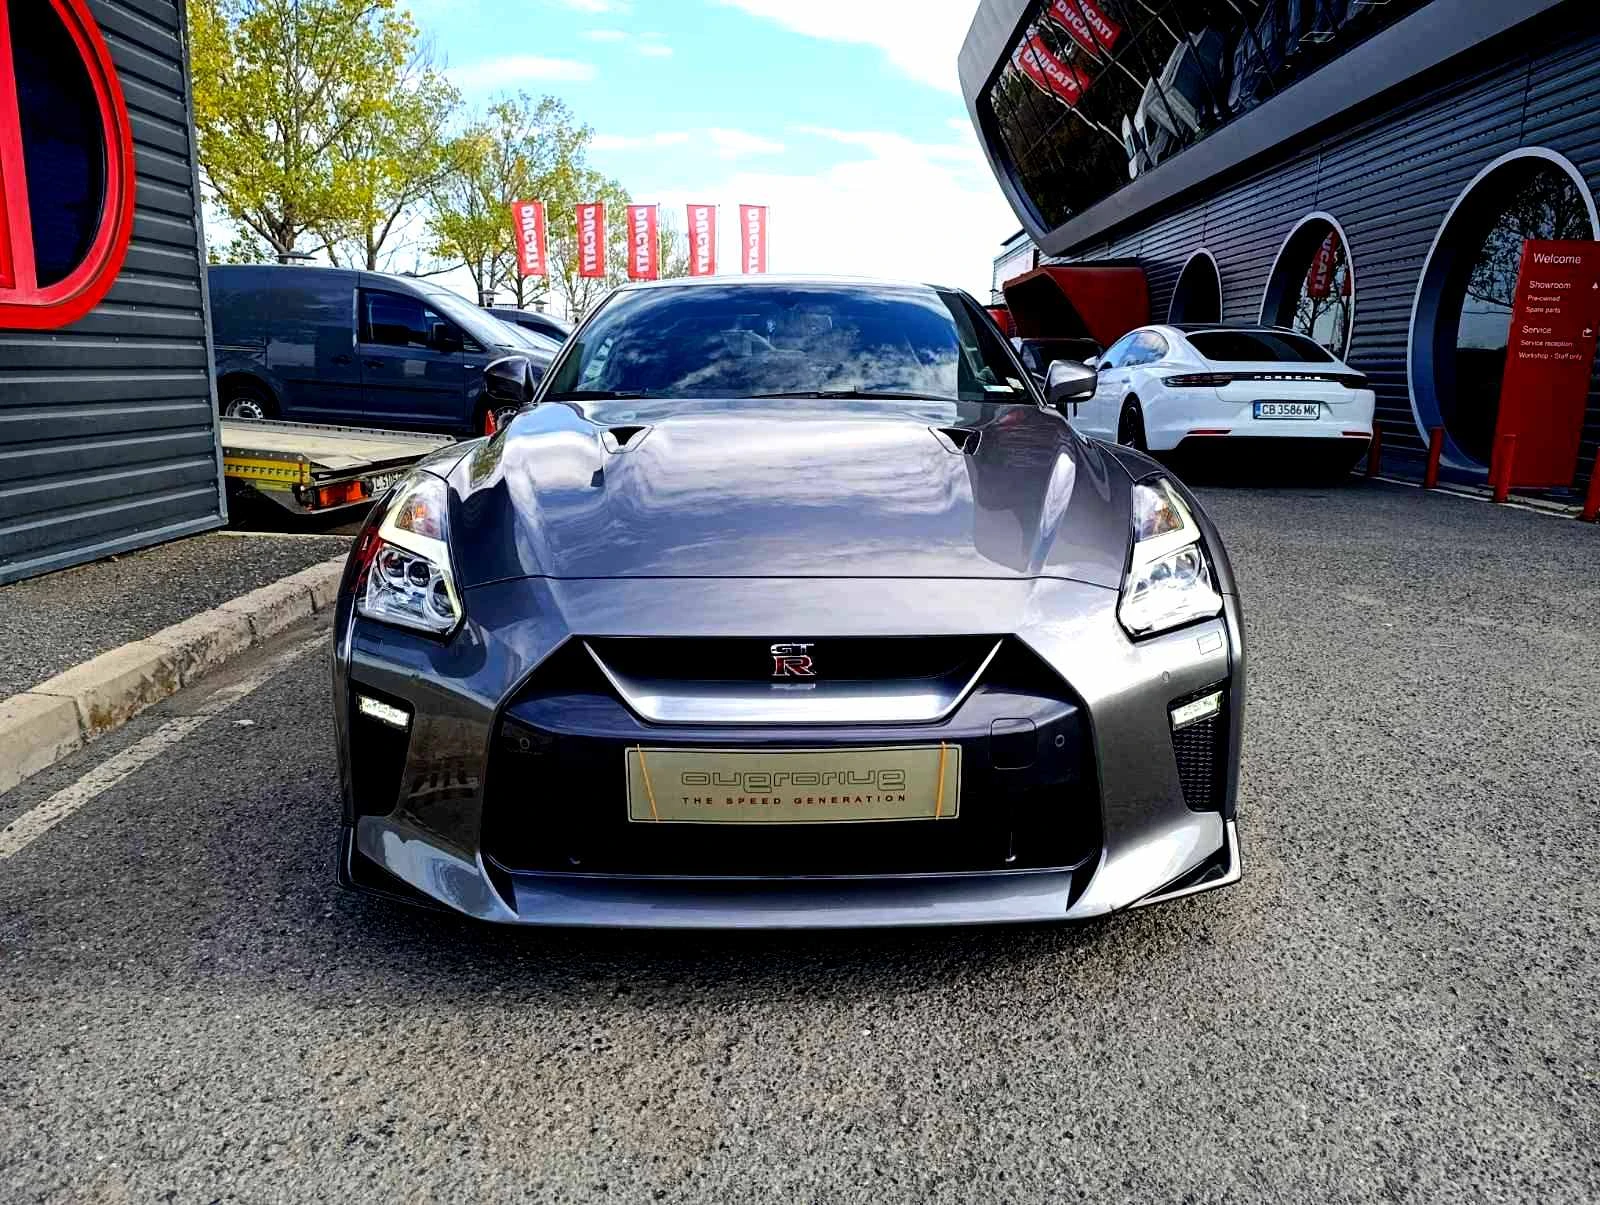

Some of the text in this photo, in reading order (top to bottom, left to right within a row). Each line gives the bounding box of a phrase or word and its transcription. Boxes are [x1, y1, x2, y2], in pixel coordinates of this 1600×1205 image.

[1533, 253, 1581, 264] Welcome
[1529, 280, 1571, 289] Showroom
[1521, 324, 1552, 334] Service
[1518, 351, 1549, 359] Workshop
[1262, 404, 1317, 416] CB 3586 MK
[680, 795, 906, 805] THE SPEED GENERATION
